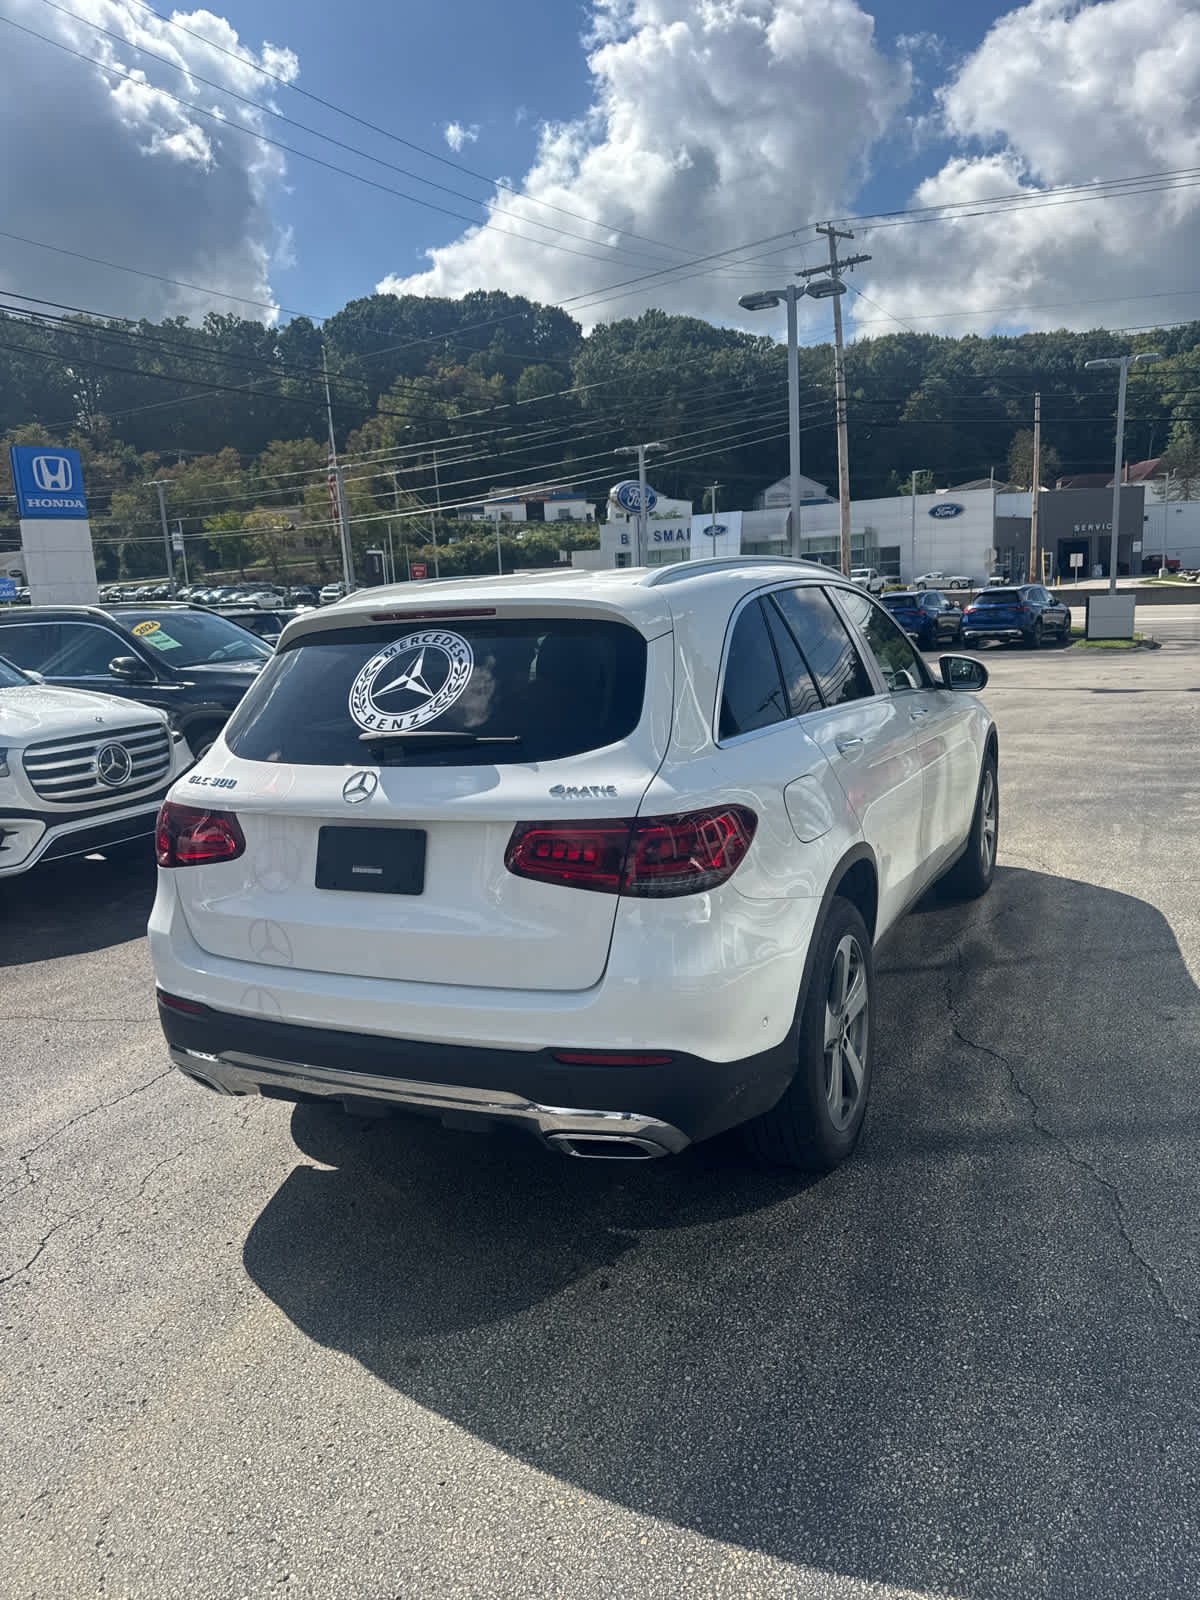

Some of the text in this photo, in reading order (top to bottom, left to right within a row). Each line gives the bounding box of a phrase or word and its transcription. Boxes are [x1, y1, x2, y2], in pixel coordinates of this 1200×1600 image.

[27, 498, 85, 508] HONDA
[935, 506, 957, 517] Ford
[1073, 522, 1113, 532] SERVIC
[384, 634, 465, 659] MERCEDES
[364, 713, 421, 730] BENZ
[188, 775, 238, 790] GLC 300
